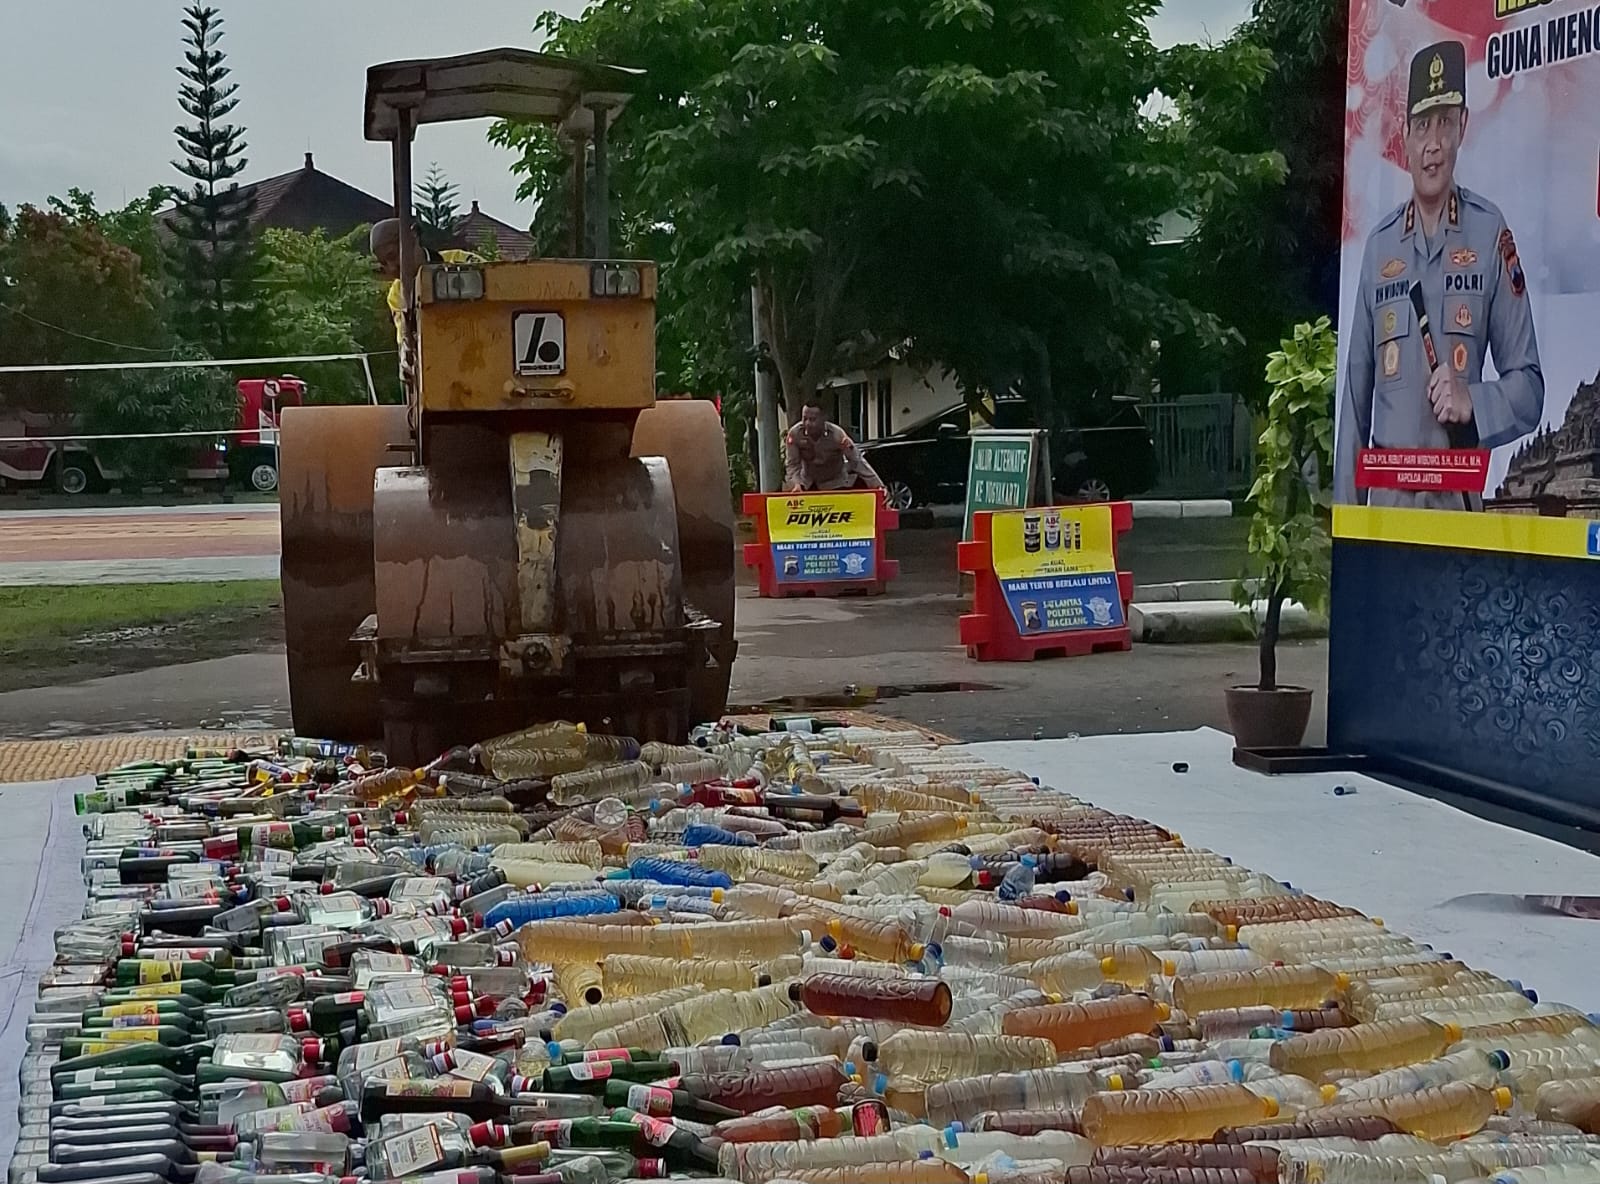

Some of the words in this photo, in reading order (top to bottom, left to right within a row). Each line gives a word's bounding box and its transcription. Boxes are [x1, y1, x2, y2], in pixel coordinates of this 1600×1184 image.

[1487, 25, 1542, 79] GUNA
[1445, 274, 1483, 291] POLRI
[975, 449, 992, 470] JALUR
[994, 449, 1027, 472] ALTERNATIF
[975, 481, 984, 502] KE
[986, 481, 1020, 506] YOGYAKARTA
[787, 512, 853, 528] POWER
[1045, 517, 1060, 525] ABC
[1025, 522, 1038, 530] ABC
[819, 541, 847, 549] BERLALU
[806, 560, 838, 568] POLRESTA
[1008, 583, 1028, 591] MARI
[1030, 581, 1054, 590] TERTIB
[1055, 579, 1086, 588] BERLALU
[1088, 577, 1111, 585] LINTAS
[1043, 598, 1083, 608] SATLANTAS
[1047, 608, 1083, 618] POLRESTA
[1047, 617, 1088, 627] MAGELANG
